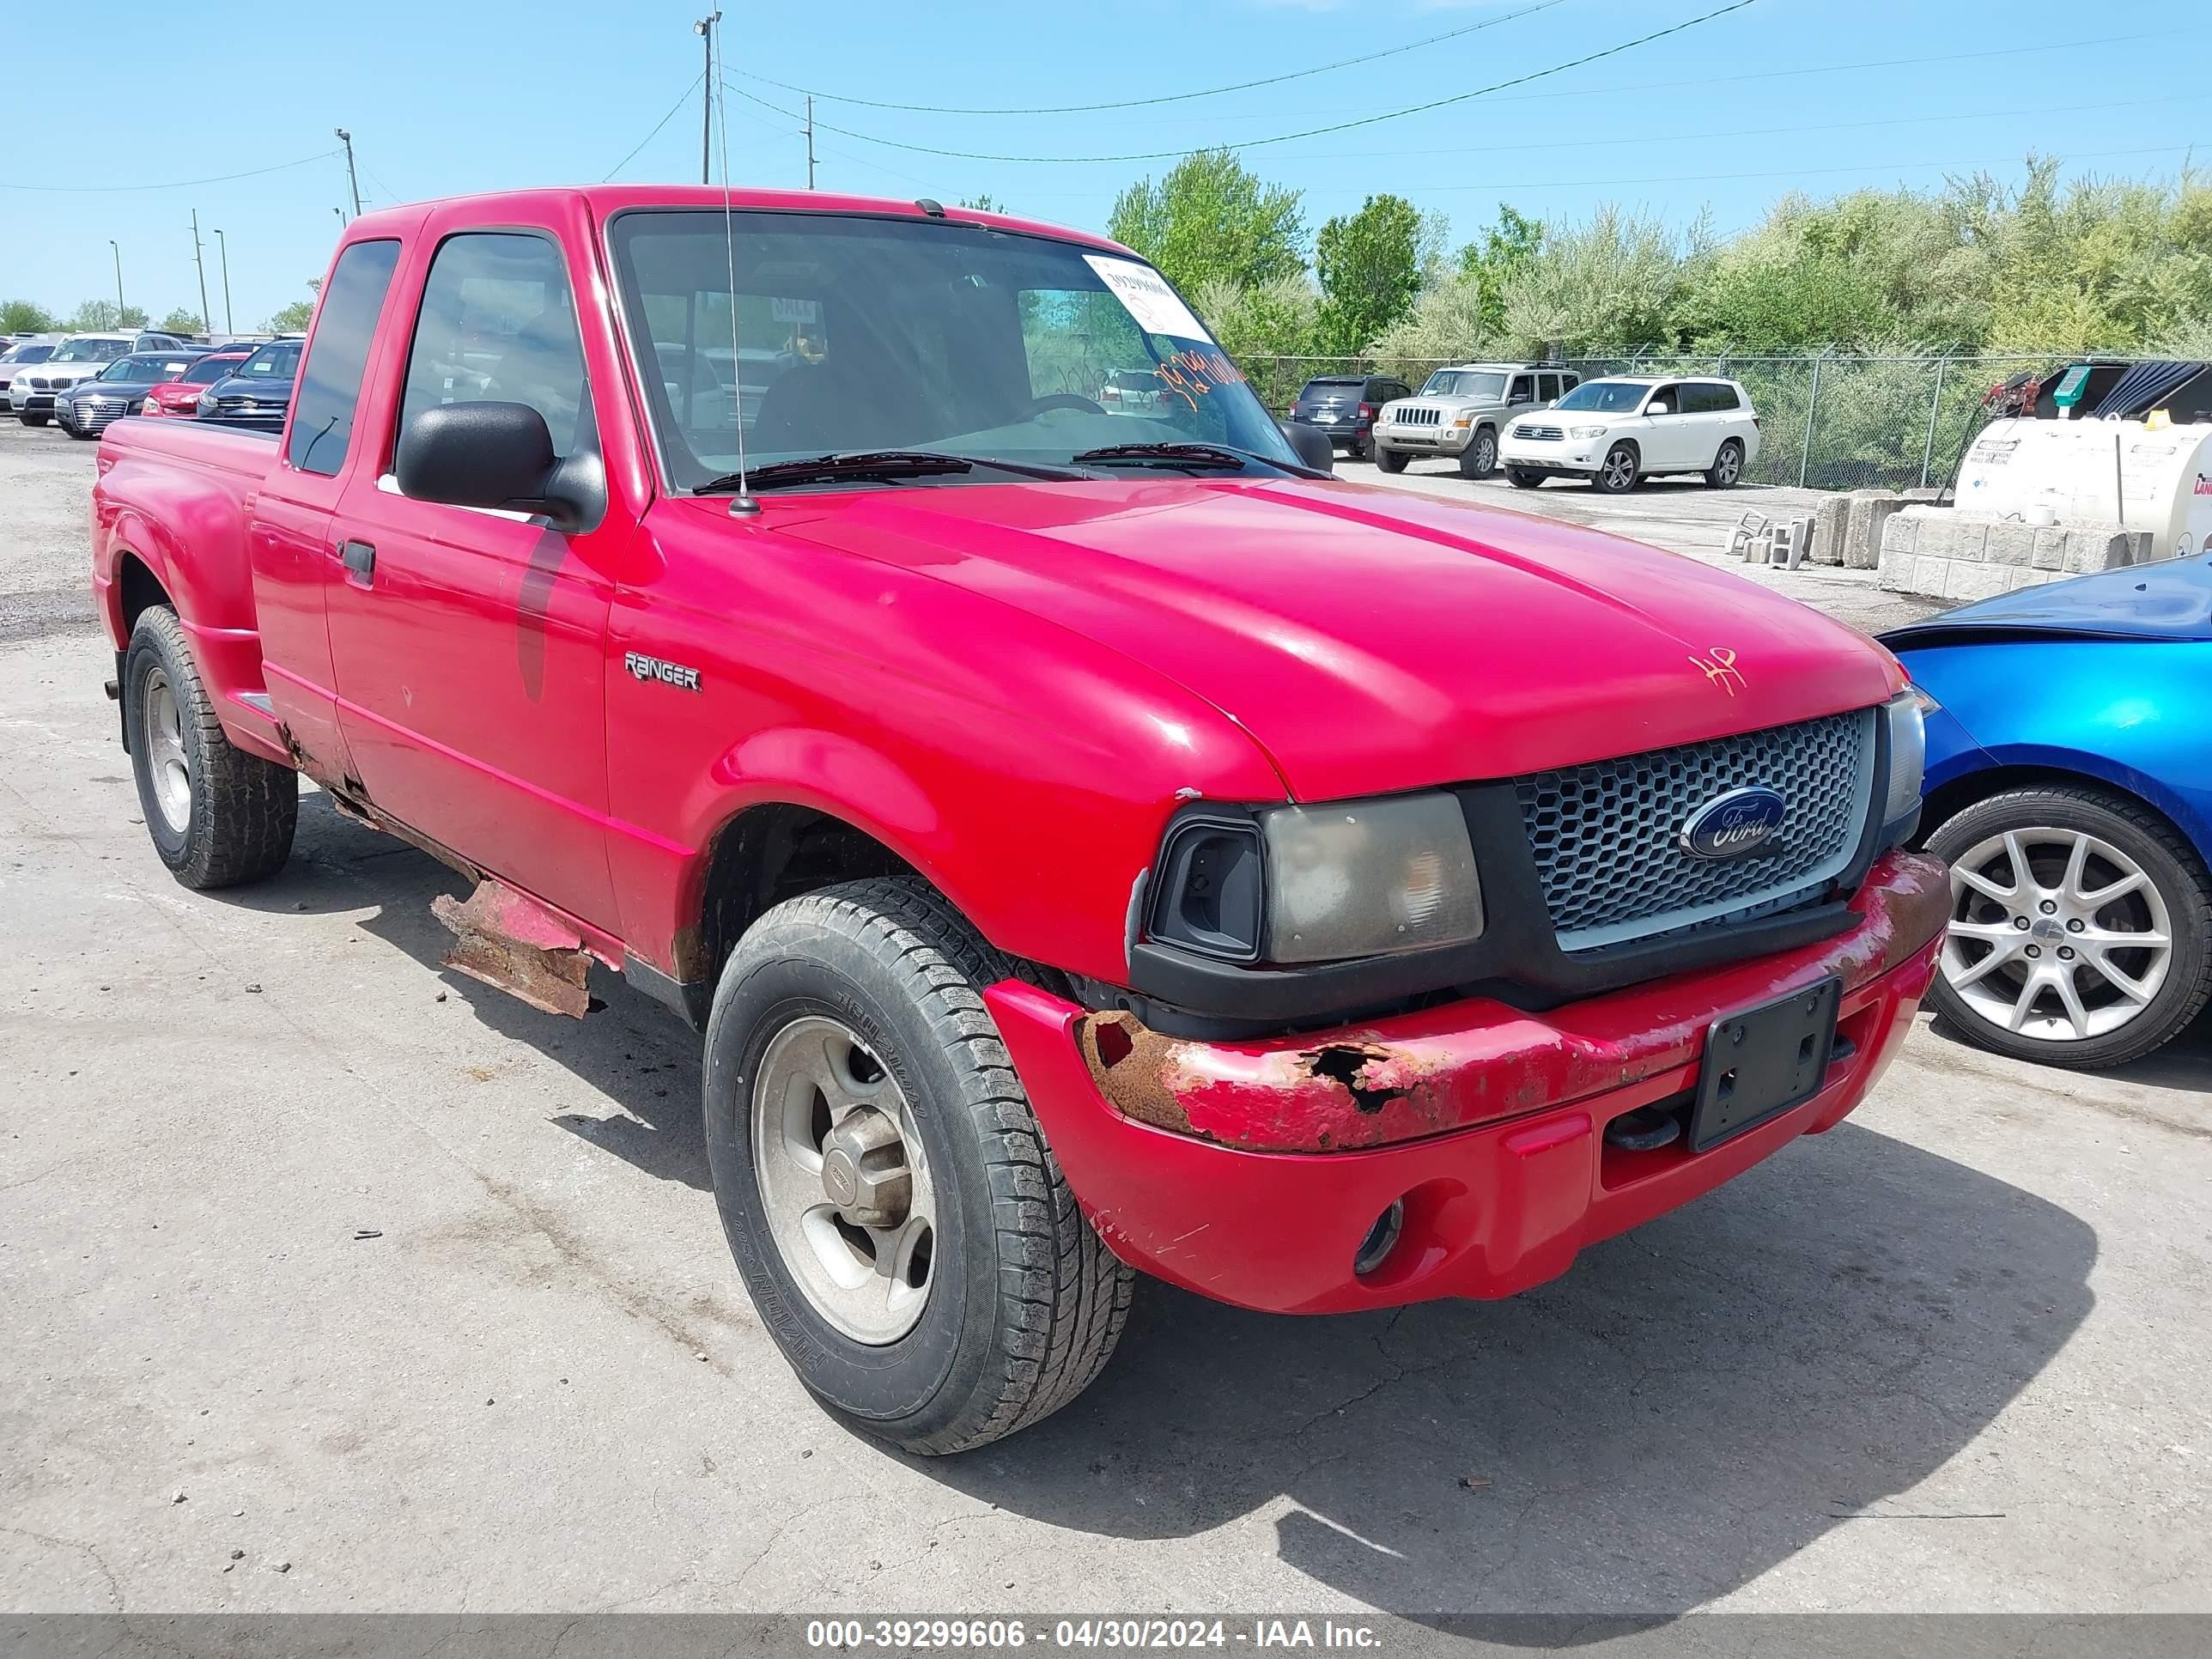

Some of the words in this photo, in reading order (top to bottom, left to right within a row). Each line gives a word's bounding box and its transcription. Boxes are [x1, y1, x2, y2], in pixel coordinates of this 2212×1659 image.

[625, 651, 700, 690] RANGER
[1712, 799, 1772, 848] Ford
[750, 1273, 828, 1374] FUZION
